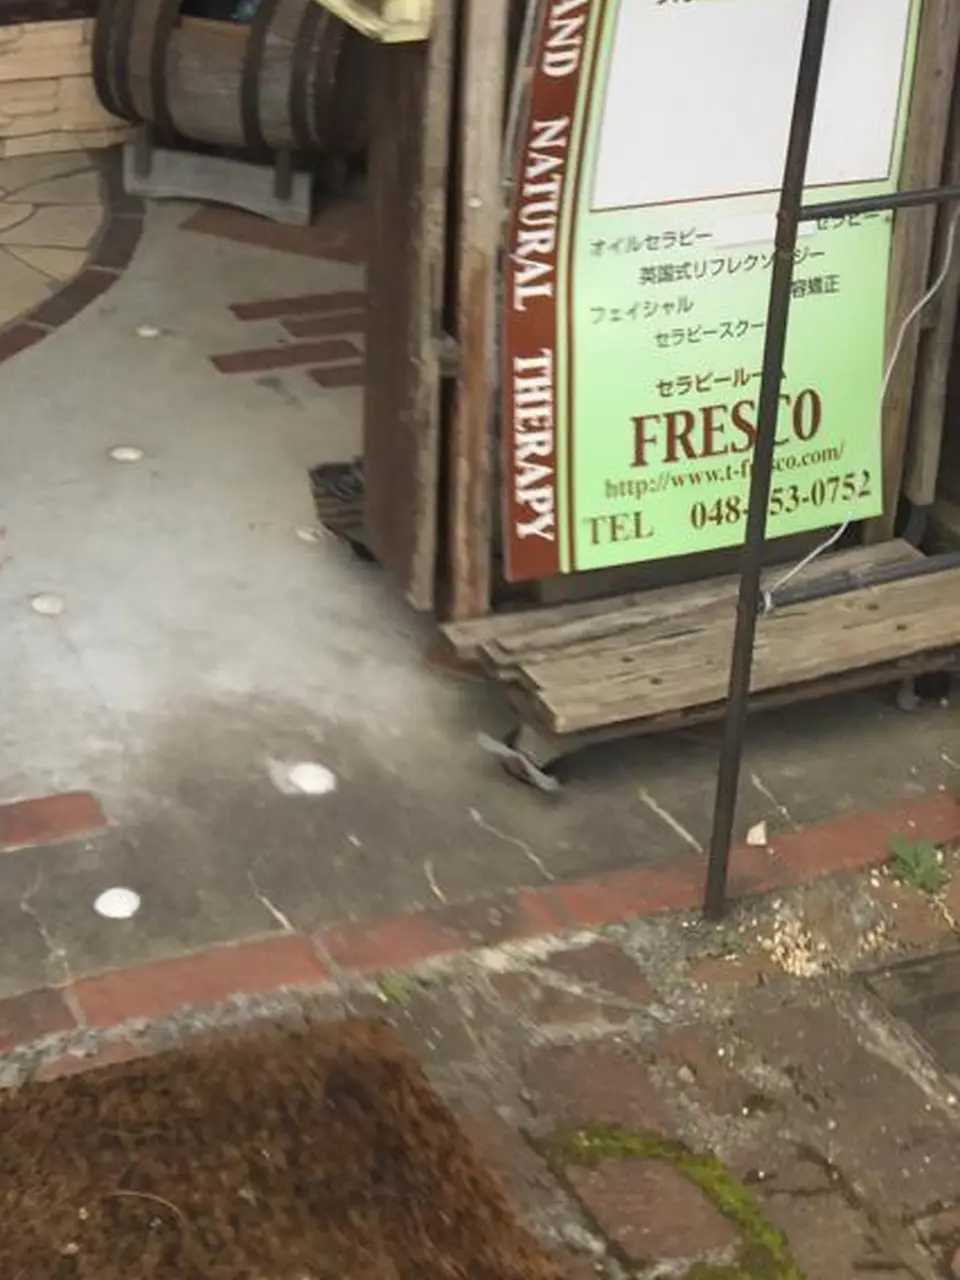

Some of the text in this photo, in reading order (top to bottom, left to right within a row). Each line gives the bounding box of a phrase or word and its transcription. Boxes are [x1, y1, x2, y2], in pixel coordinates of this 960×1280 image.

[508, 116, 571, 312] NATURAL
[639, 246, 825, 285] 英国式リフレクソジー
[782, 274, 841, 299] 容矯正
[590, 295, 695, 325] フェイシャル
[654, 320, 768, 349] セラピースクー
[655, 367, 786, 398] セラピールー
[511, 348, 557, 542] THERAPY
[603, 438, 846, 501] http://www.t-fco.com/
[583, 469, 872, 546] TEL 048-53-0752
